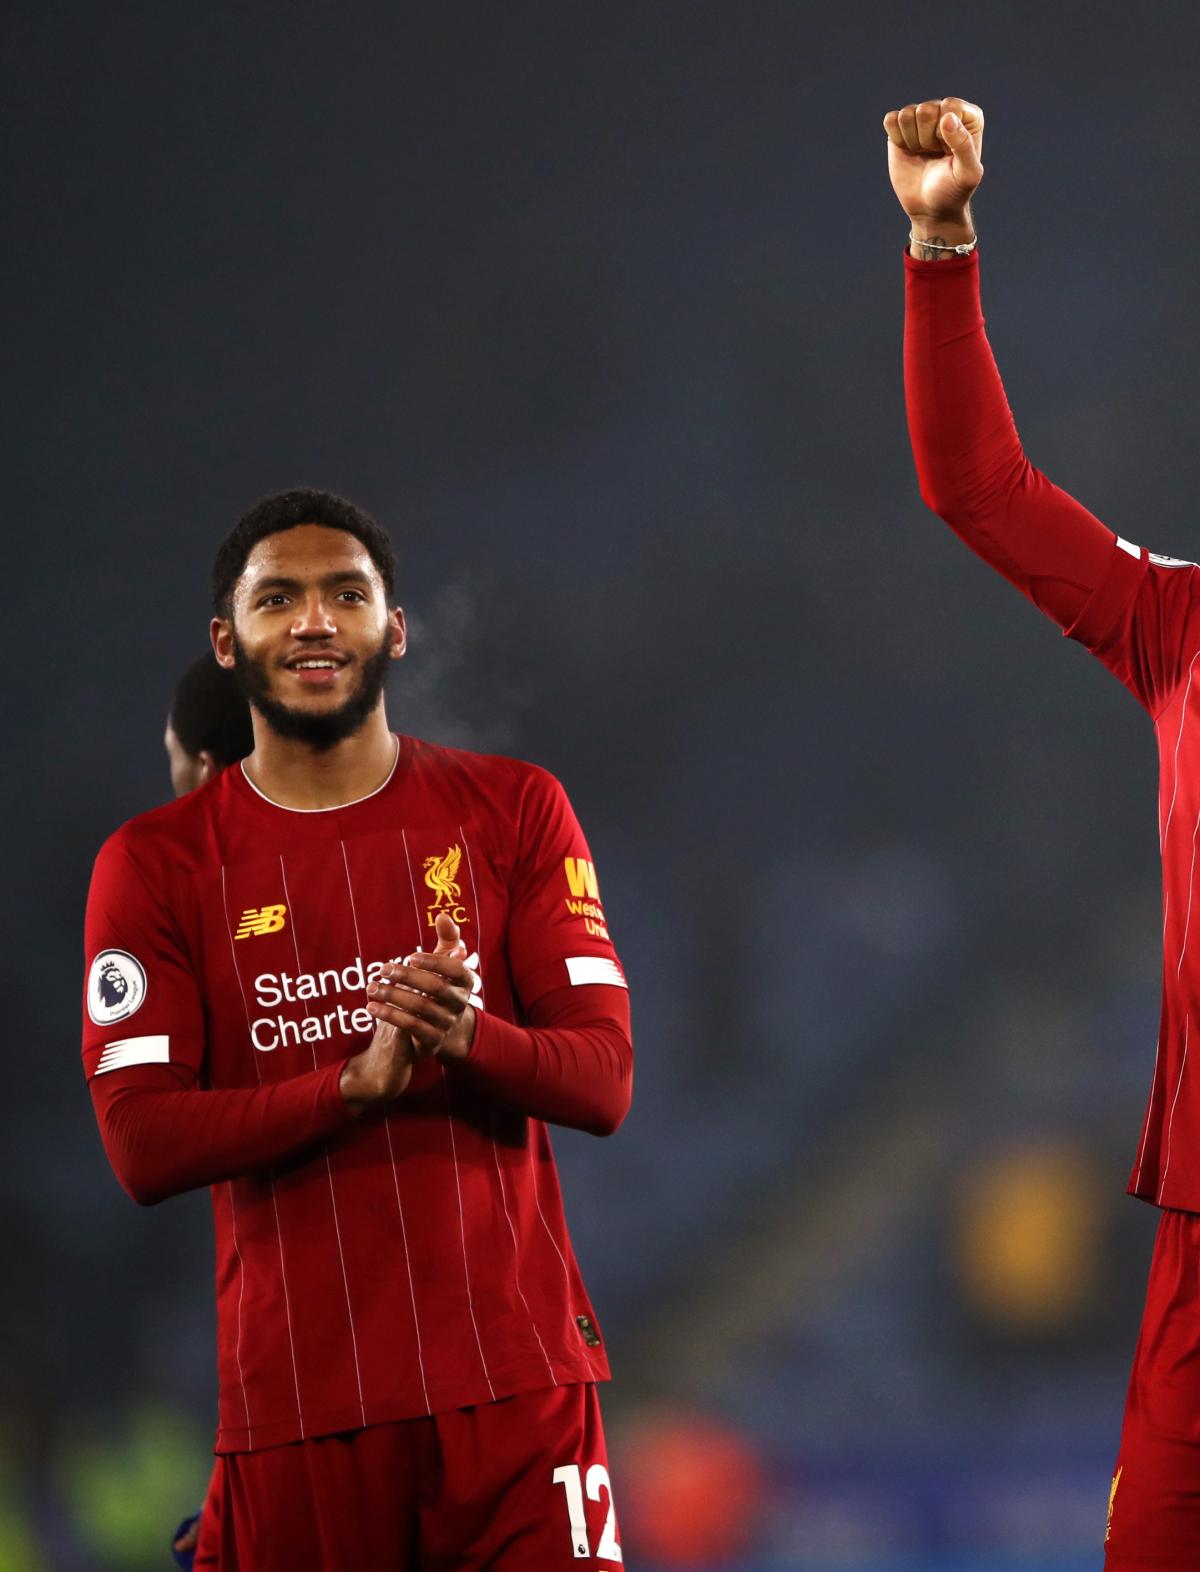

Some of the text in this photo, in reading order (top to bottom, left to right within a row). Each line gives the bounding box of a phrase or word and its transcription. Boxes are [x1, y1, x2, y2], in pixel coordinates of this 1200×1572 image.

[564, 856, 602, 906] W
[250, 1003, 374, 1053] Charte
[552, 1463, 623, 1564] 12
